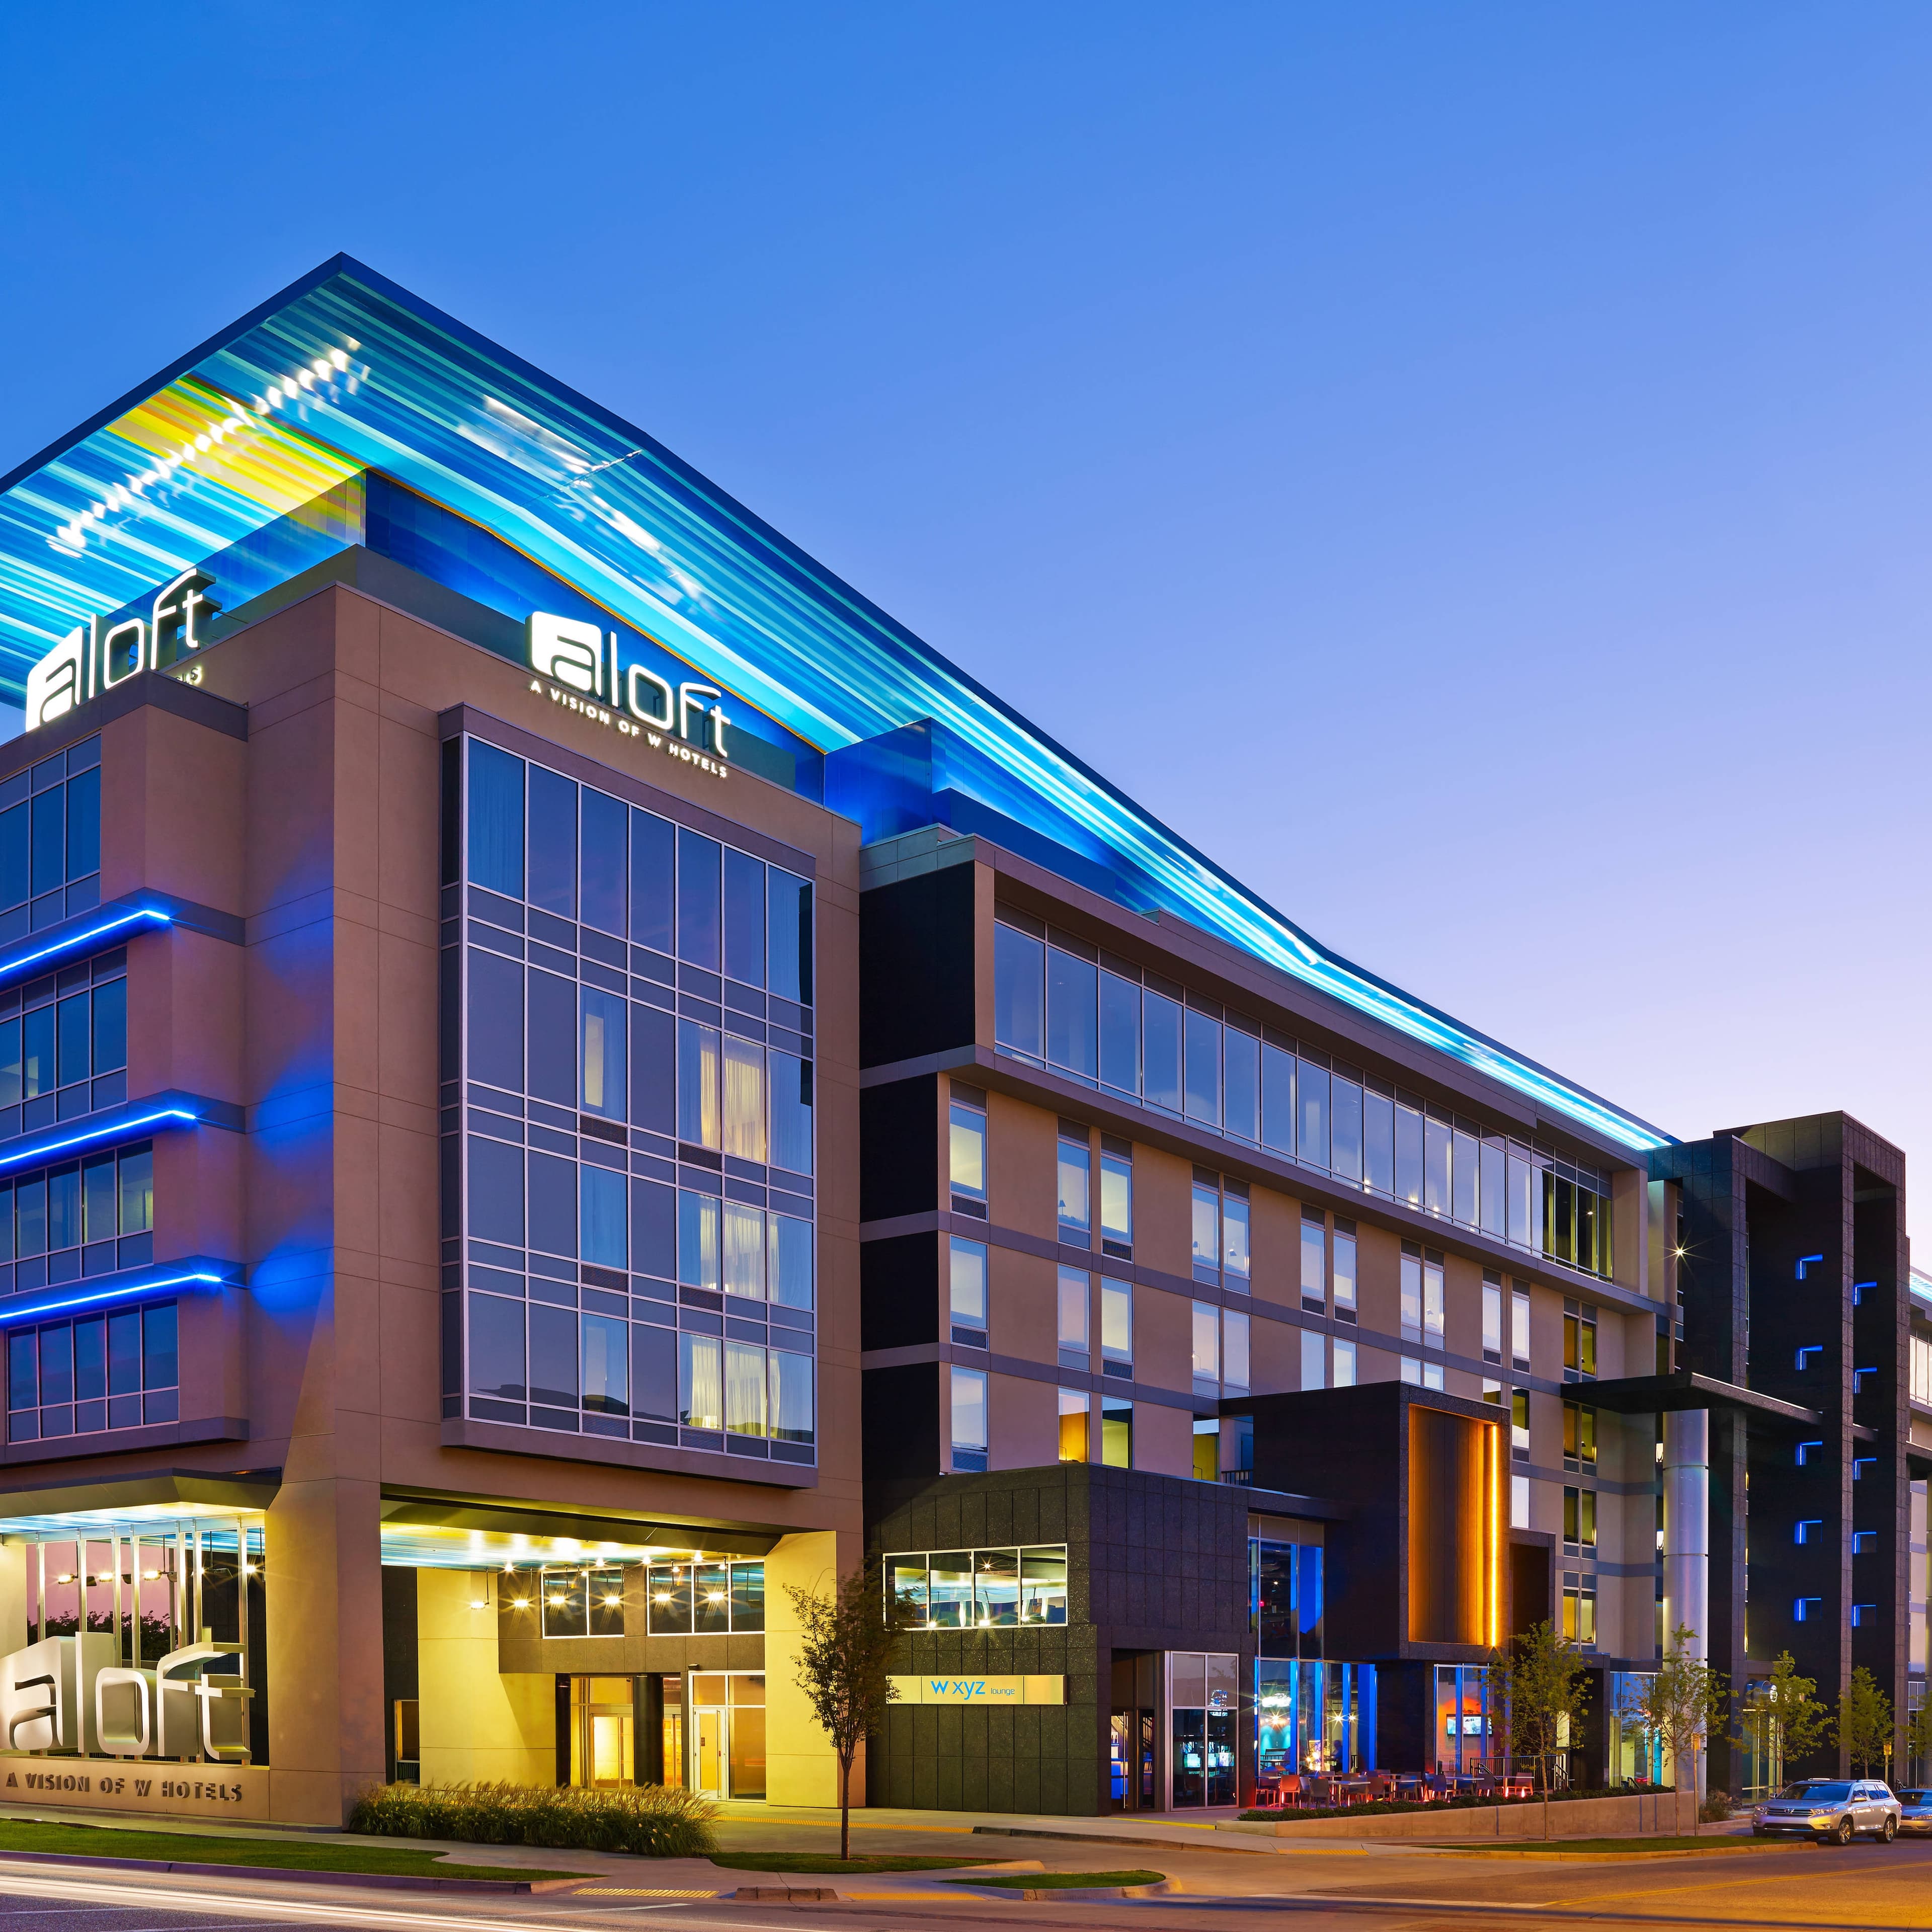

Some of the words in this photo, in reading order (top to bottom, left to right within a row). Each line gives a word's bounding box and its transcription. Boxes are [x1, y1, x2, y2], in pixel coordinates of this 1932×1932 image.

[26, 568, 203, 732] aloft
[531, 611, 731, 758] aloft
[530, 680, 542, 694] A
[549, 687, 610, 725] VISION
[618, 720, 639, 737] OF
[647, 732, 662, 748] W
[669, 743, 728, 778] HOTELS
[0, 1632, 253, 1761] aloft
[990, 1687, 1015, 1696] lounge
[6, 1772, 19, 1788] A
[25, 1773, 90, 1792] VISION
[99, 1777, 125, 1794] OF
[133, 1779, 152, 1797] W
[160, 1780, 243, 1802] HOTELS
